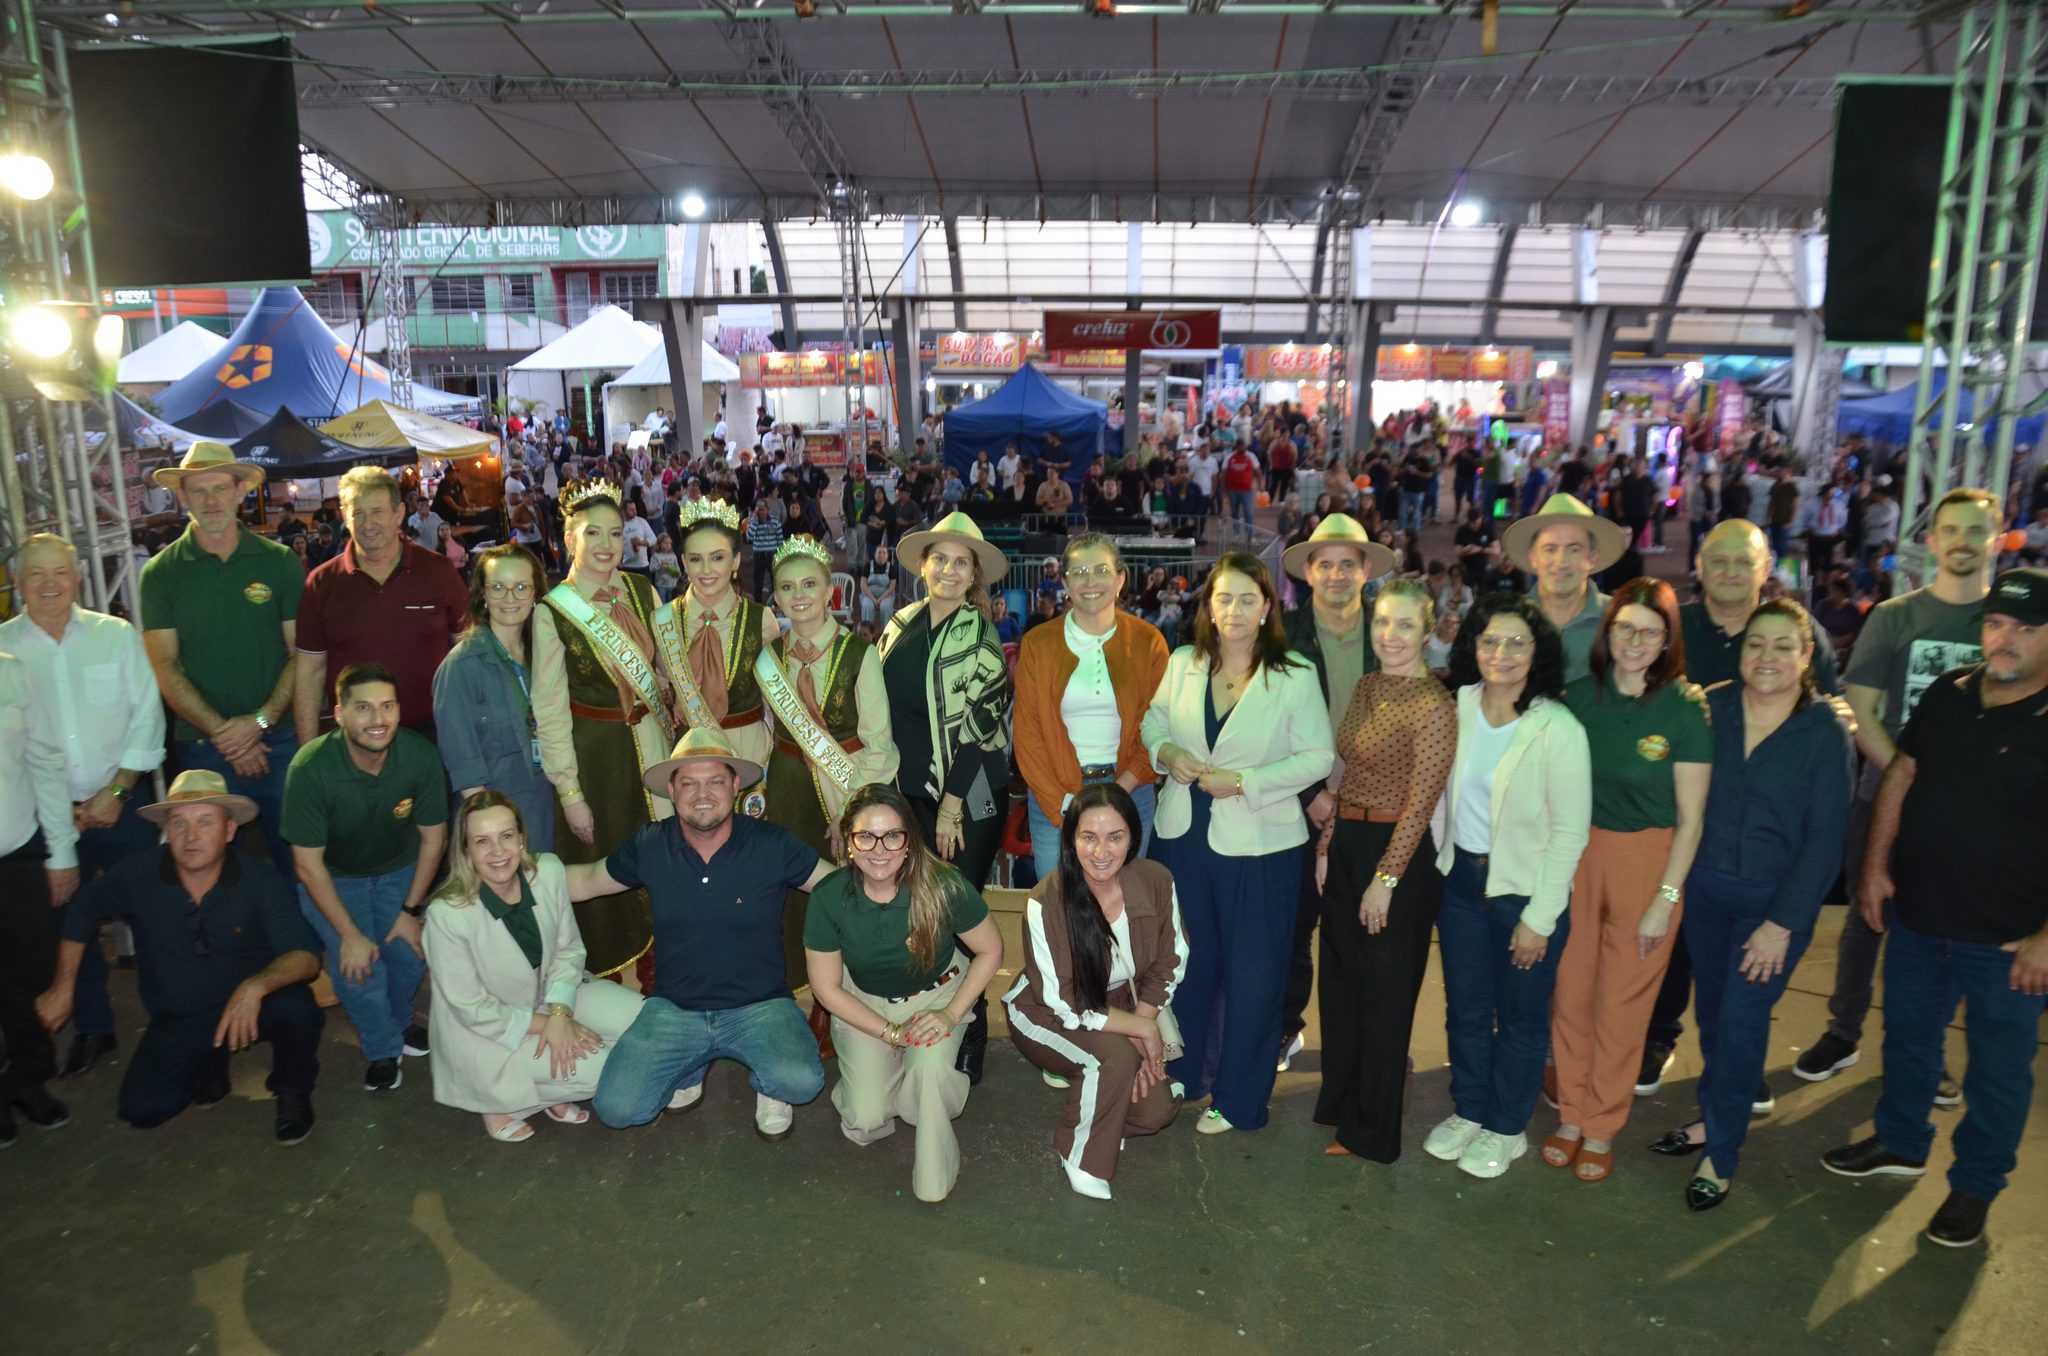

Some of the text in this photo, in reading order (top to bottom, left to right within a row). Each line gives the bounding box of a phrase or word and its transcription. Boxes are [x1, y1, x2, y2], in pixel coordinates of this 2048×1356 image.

[425, 245, 470, 258] OFICIAL
[476, 244, 493, 257] DE
[594, 621, 648, 685] PRINCESA
[658, 620, 698, 705] RAINHA
[773, 685, 822, 750] PRINCESA
[823, 745, 854, 779] SEBER
